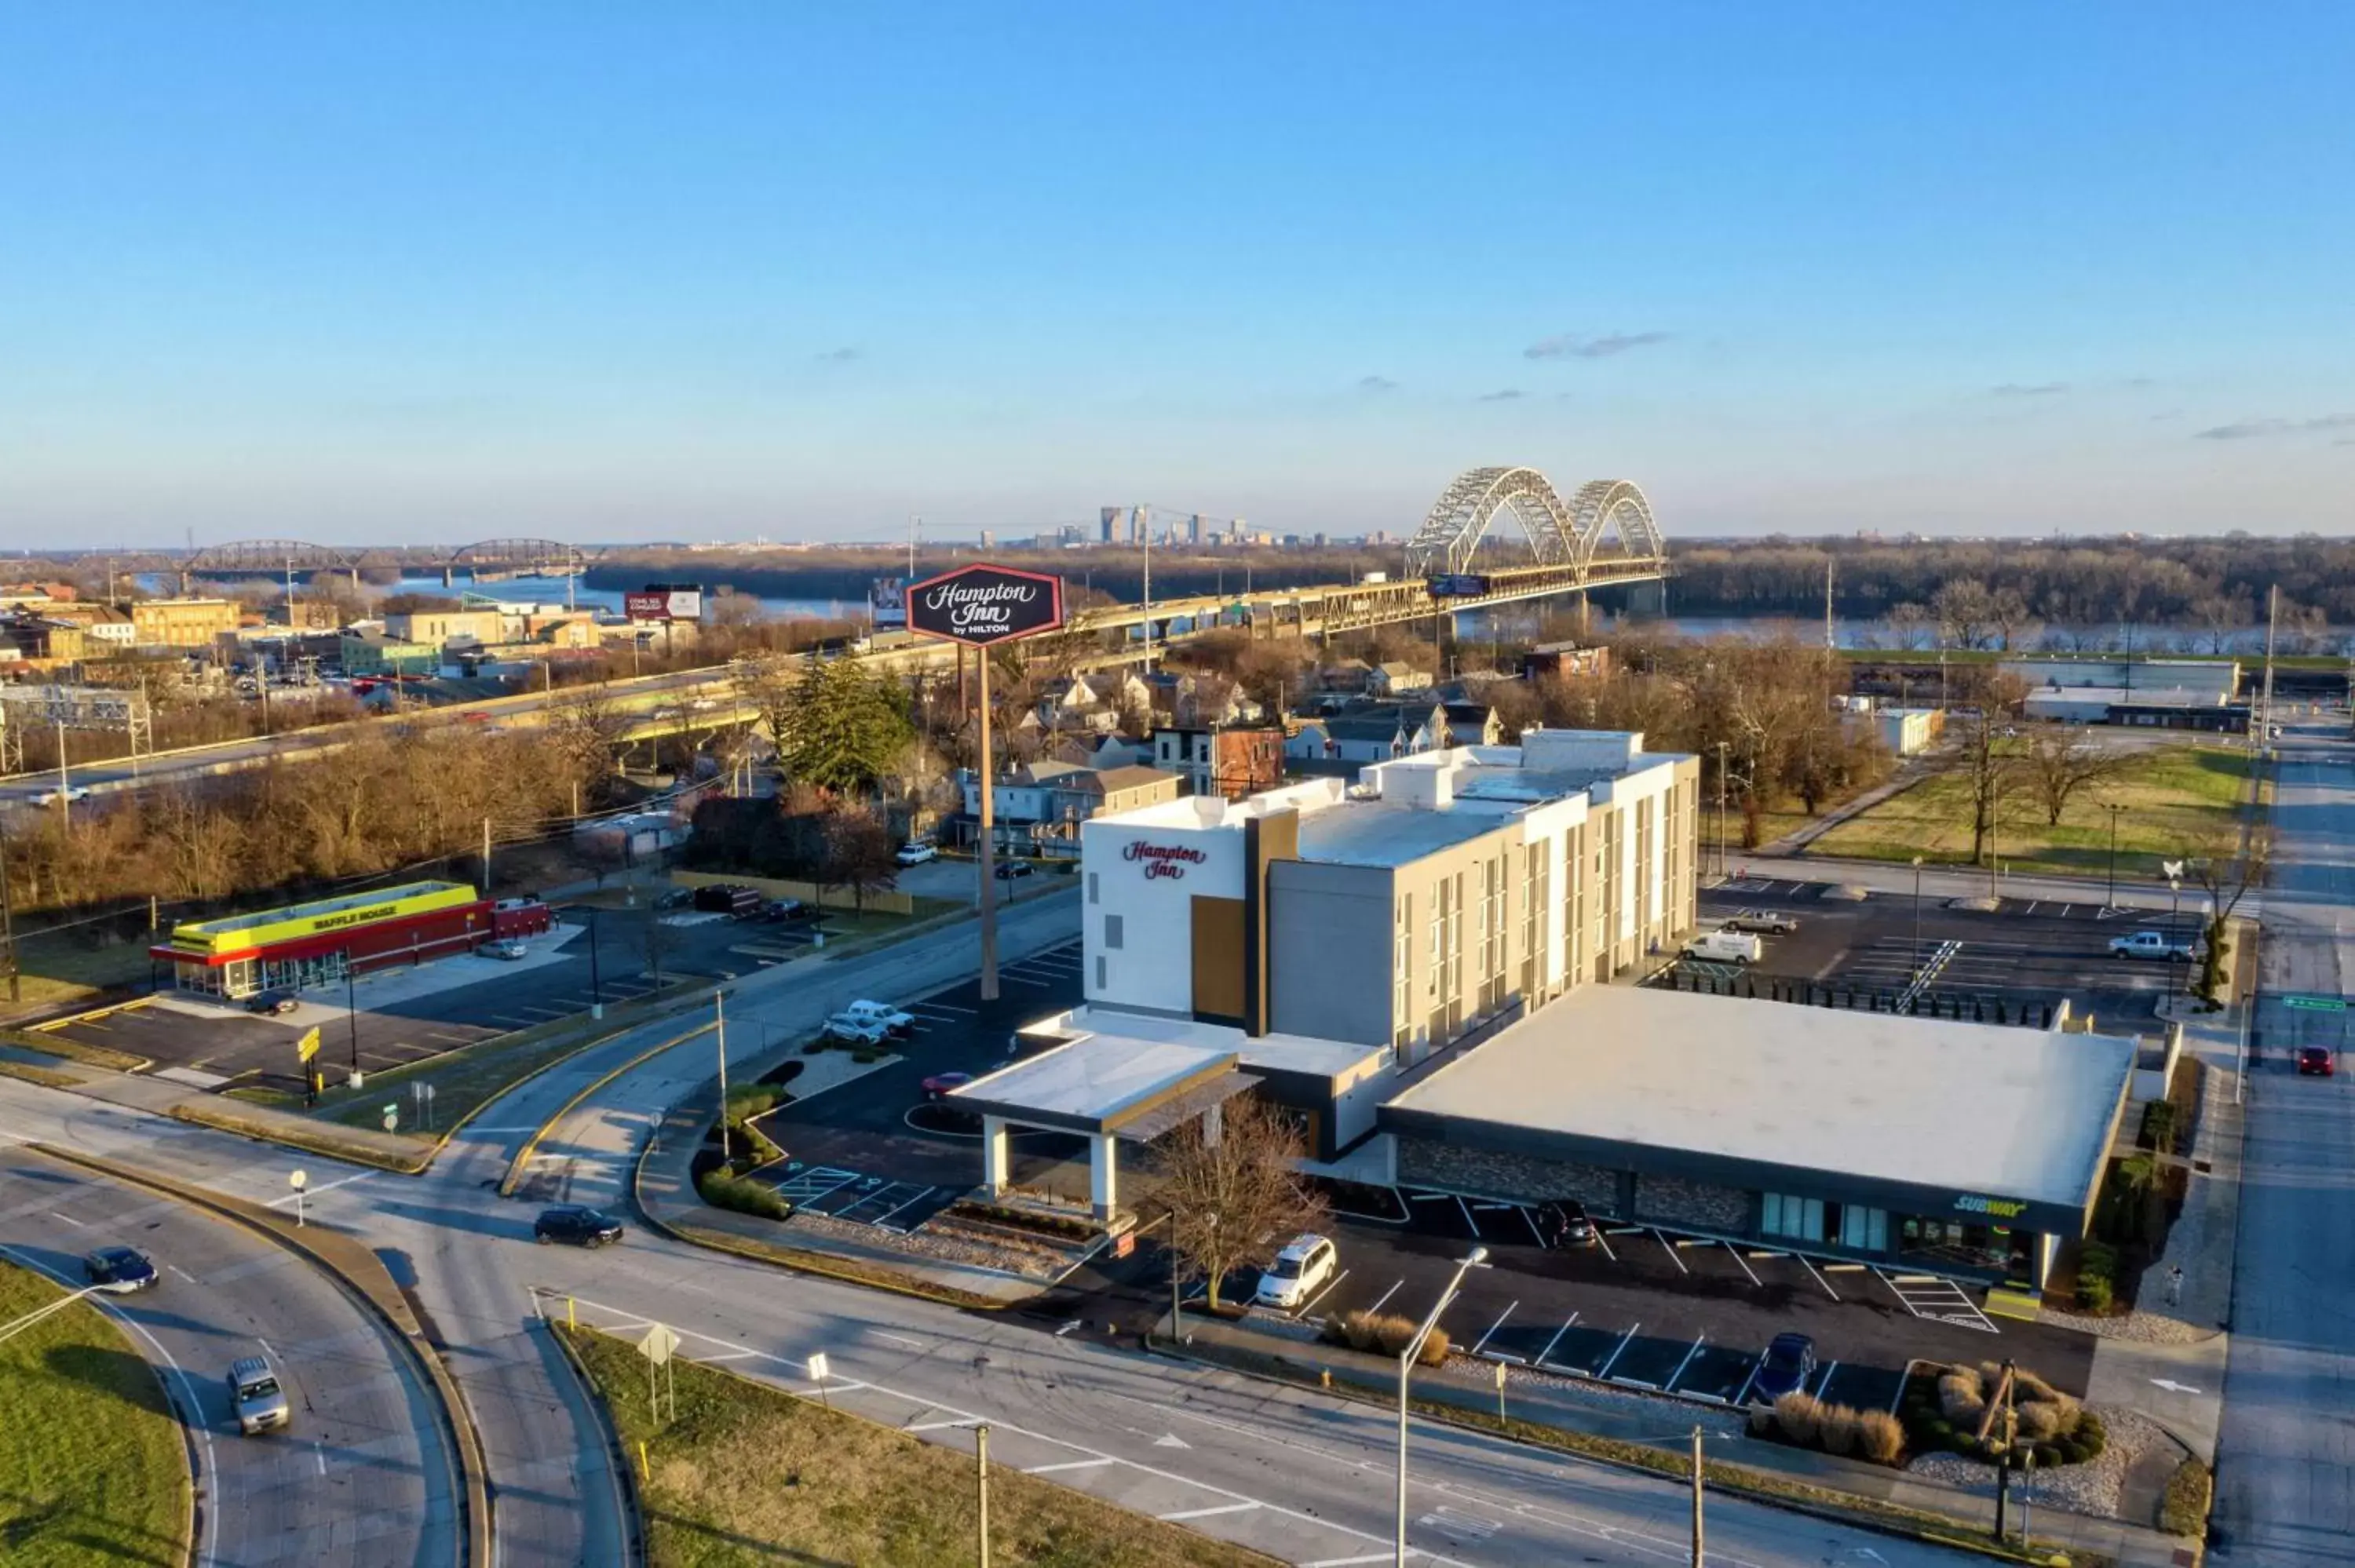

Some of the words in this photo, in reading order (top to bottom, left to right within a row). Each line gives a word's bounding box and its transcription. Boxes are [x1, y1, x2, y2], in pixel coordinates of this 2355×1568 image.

[926, 582, 1036, 610] Hampton
[951, 602, 1011, 625] Inn
[954, 626, 966, 635] by
[969, 624, 1010, 633] HILTON
[1123, 841, 1207, 864] Hampton
[1145, 860, 1185, 880] Inn
[314, 913, 356, 929] WAFFLE
[359, 905, 396, 920] HOUSE
[1953, 1195, 2027, 1218] SUBWAY
